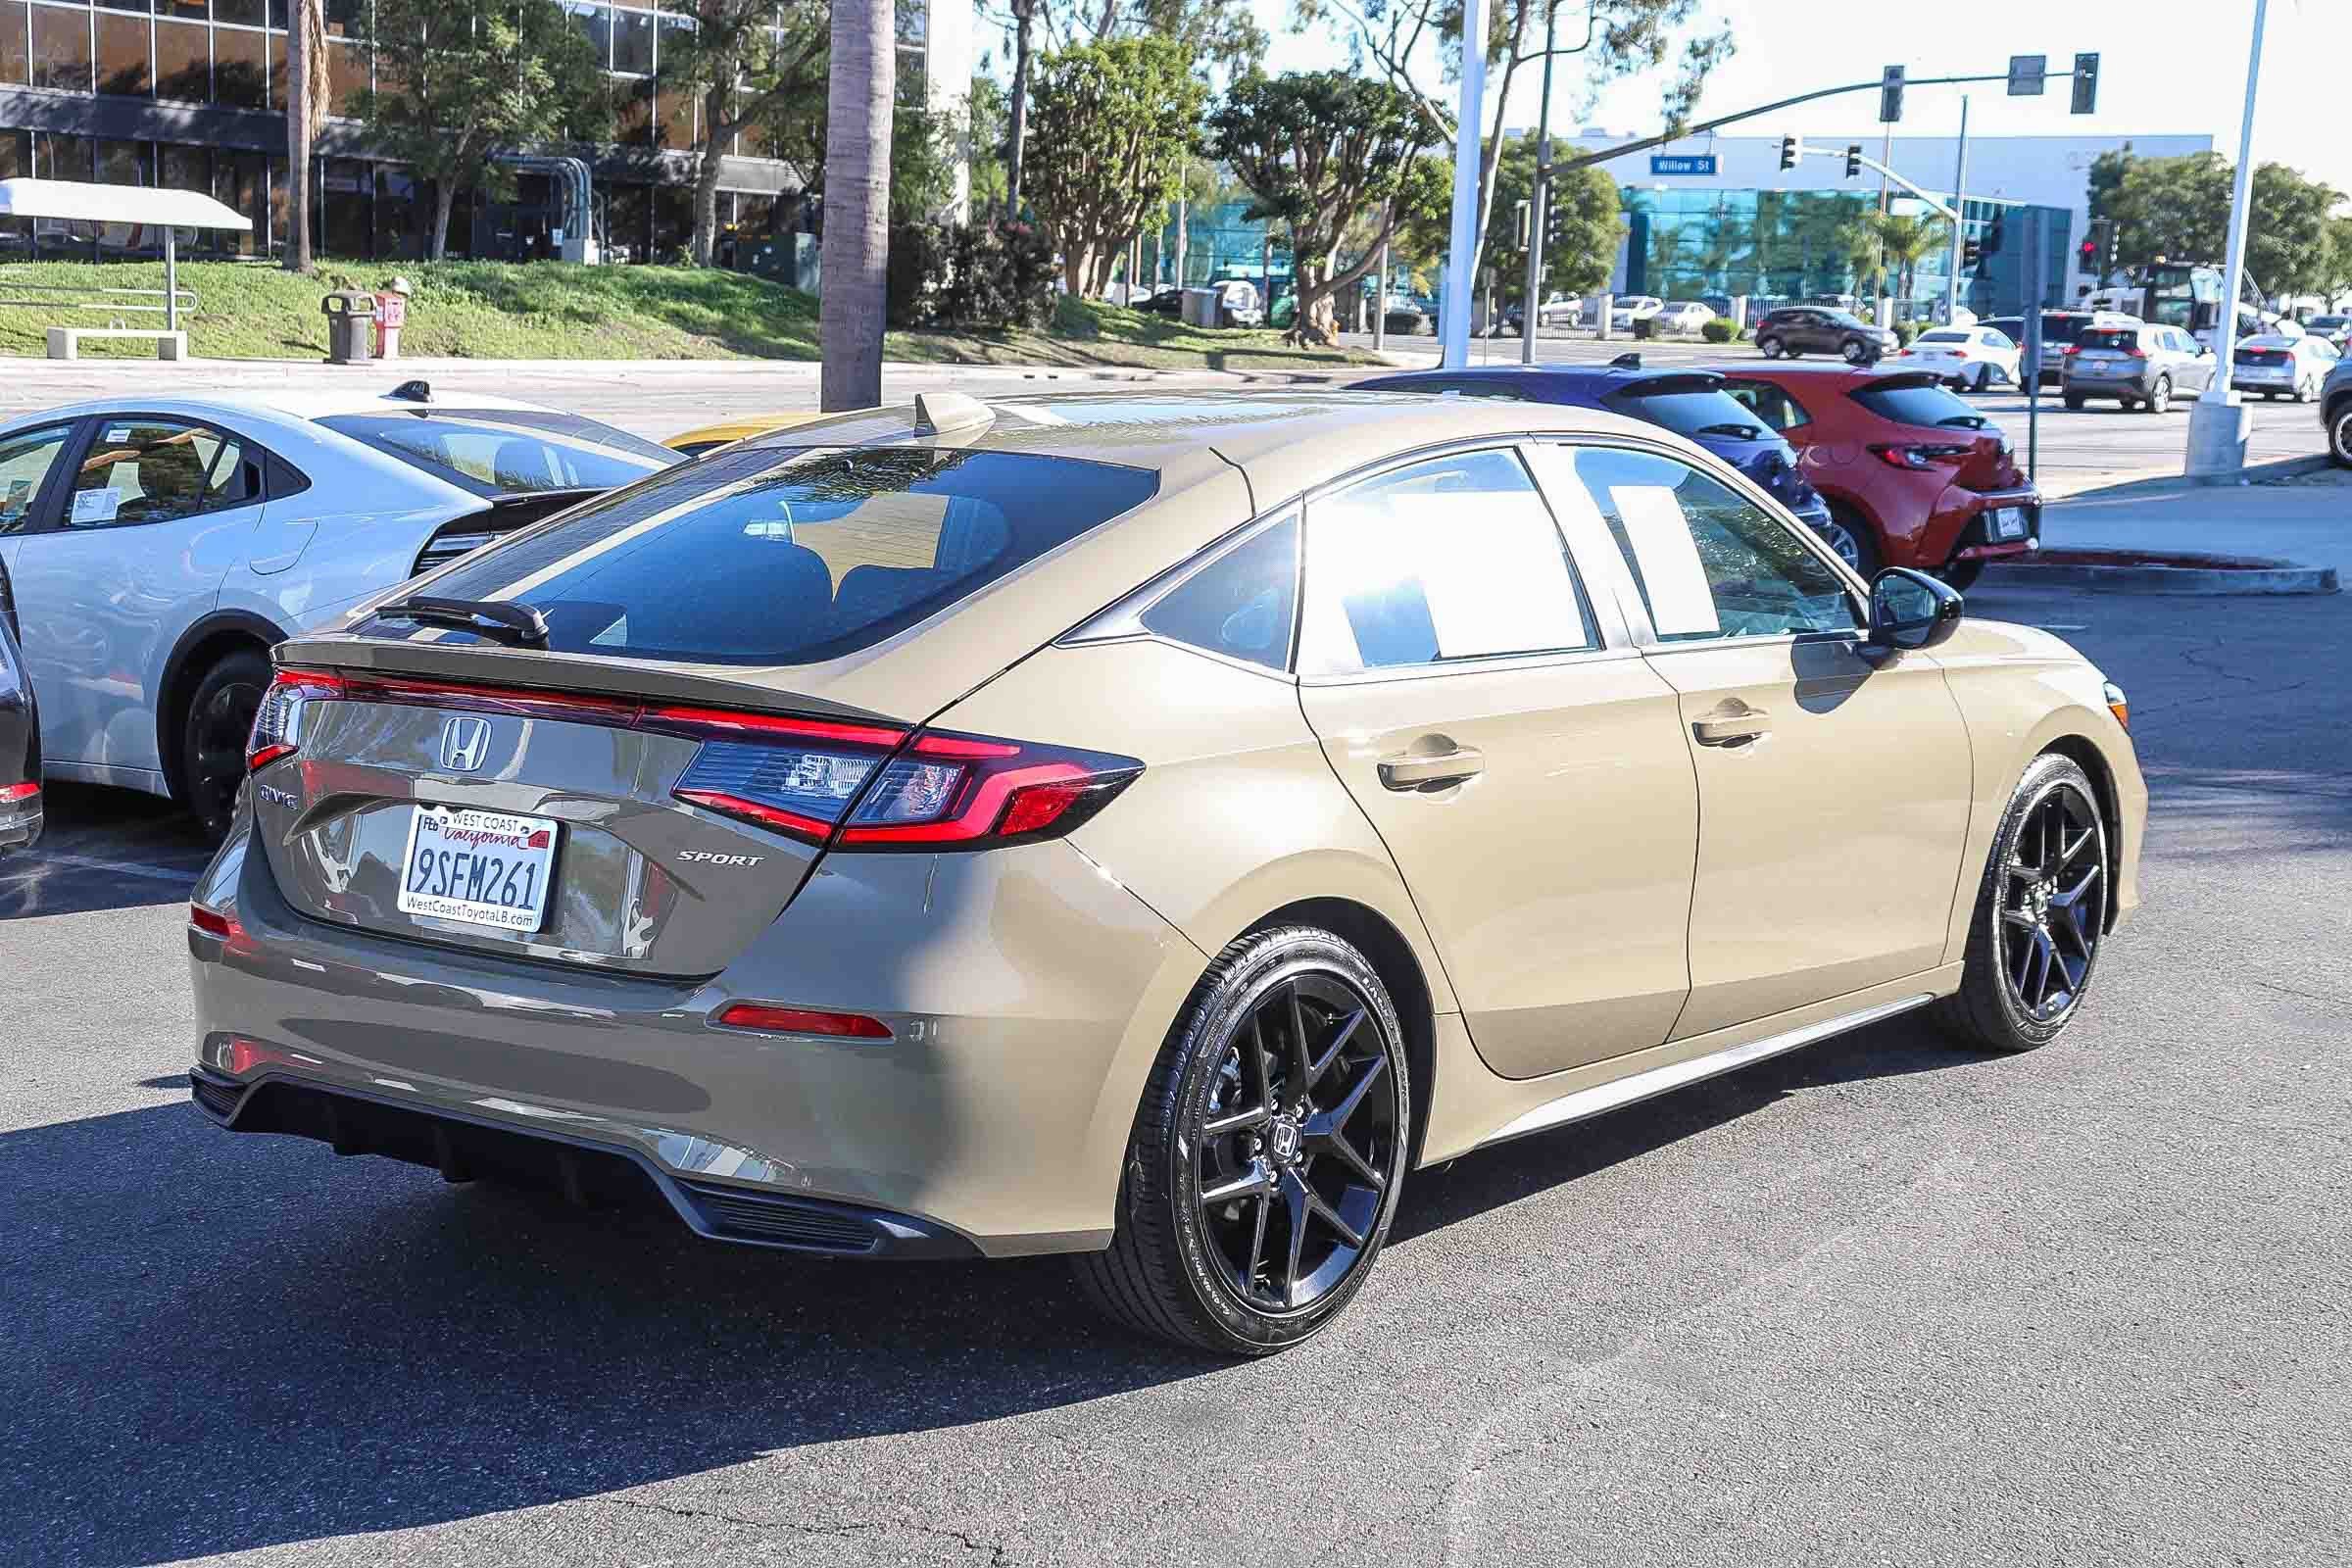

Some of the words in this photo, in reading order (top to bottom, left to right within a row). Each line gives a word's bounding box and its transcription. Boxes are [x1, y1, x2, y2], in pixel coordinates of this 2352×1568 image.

[1657, 160, 1691, 172] Willow
[1697, 160, 1709, 172] St
[453, 812, 480, 827] WEST
[483, 816, 517, 832] COAST
[676, 851, 765, 866] SPORT
[416, 848, 536, 909] 9SFM261
[407, 896, 533, 926] WestCoastToyotaLB.com
